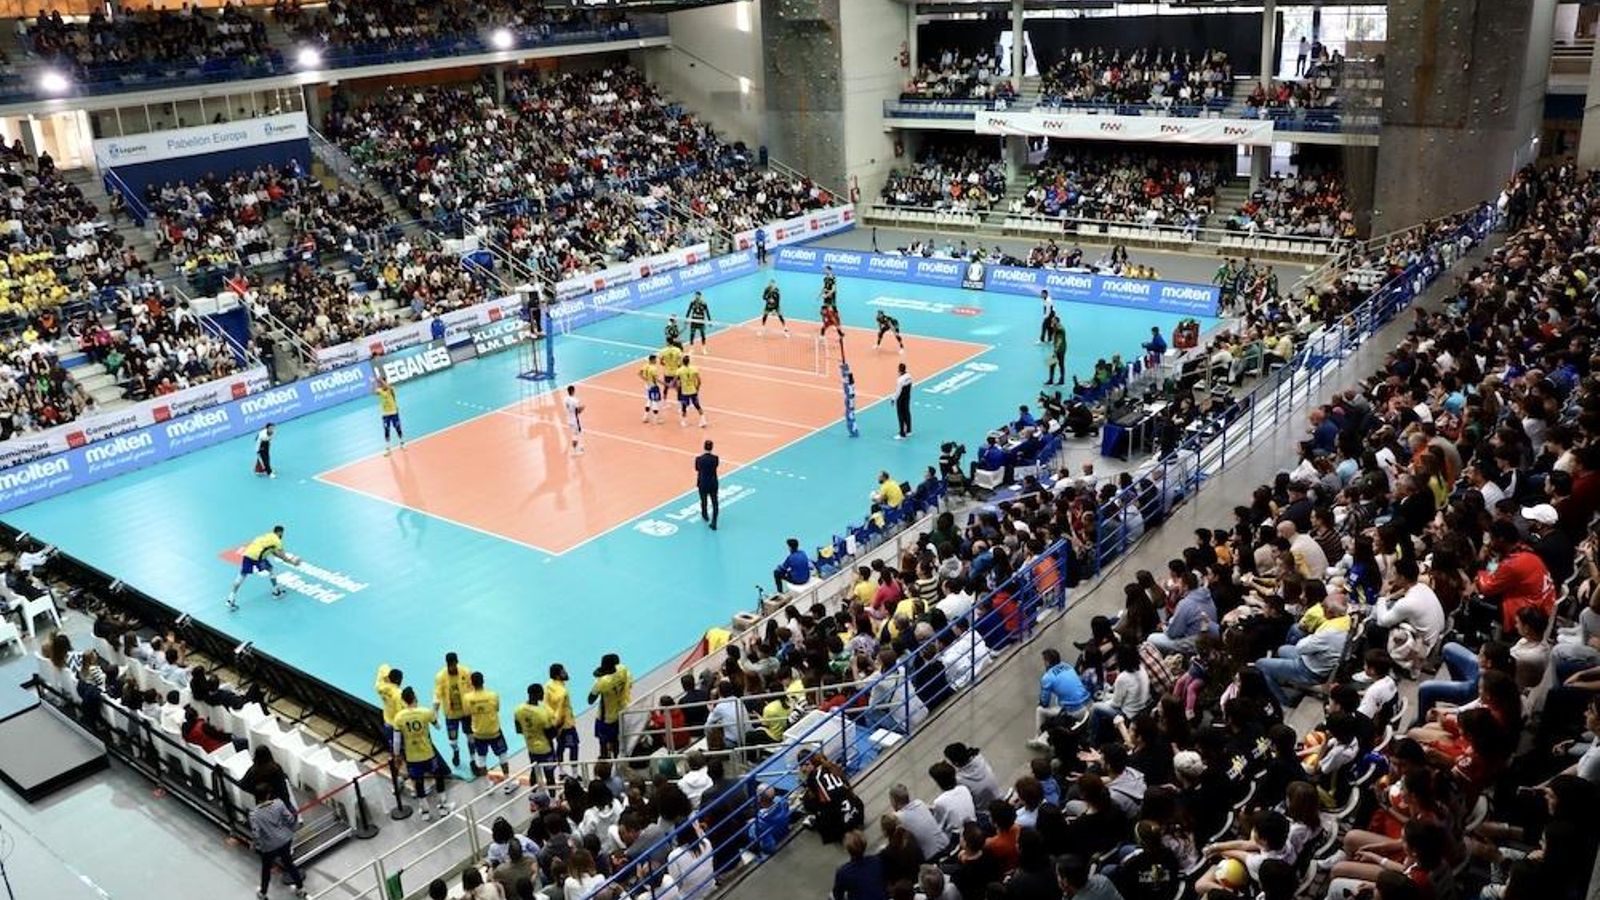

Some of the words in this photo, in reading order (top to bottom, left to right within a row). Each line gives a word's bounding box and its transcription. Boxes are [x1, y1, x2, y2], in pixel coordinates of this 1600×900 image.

[167, 135, 210, 150] Pabellón
[213, 130, 248, 144] Europa
[718, 252, 751, 268] molten
[780, 249, 817, 261] molten
[824, 253, 862, 265] molten
[870, 256, 909, 270] molten
[679, 261, 712, 281] molten
[918, 260, 958, 275] molten
[993, 269, 1037, 283] molten
[637, 274, 673, 294] molten
[1047, 273, 1092, 289] molten
[1102, 279, 1150, 295] molten
[592, 286, 631, 307] molten
[1161, 286, 1212, 302] molten
[472, 325, 504, 343] XLIX
[310, 367, 364, 394] molten
[171, 391, 218, 411] Comunidad
[240, 387, 299, 415] molten
[85, 415, 137, 436] Comunidad
[166, 408, 229, 439] molten
[0, 441, 49, 461] omunidad
[85, 431, 153, 464] molten
[0, 457, 70, 491] molten
[405, 719, 423, 733] 10
[823, 772, 844, 791] 10
